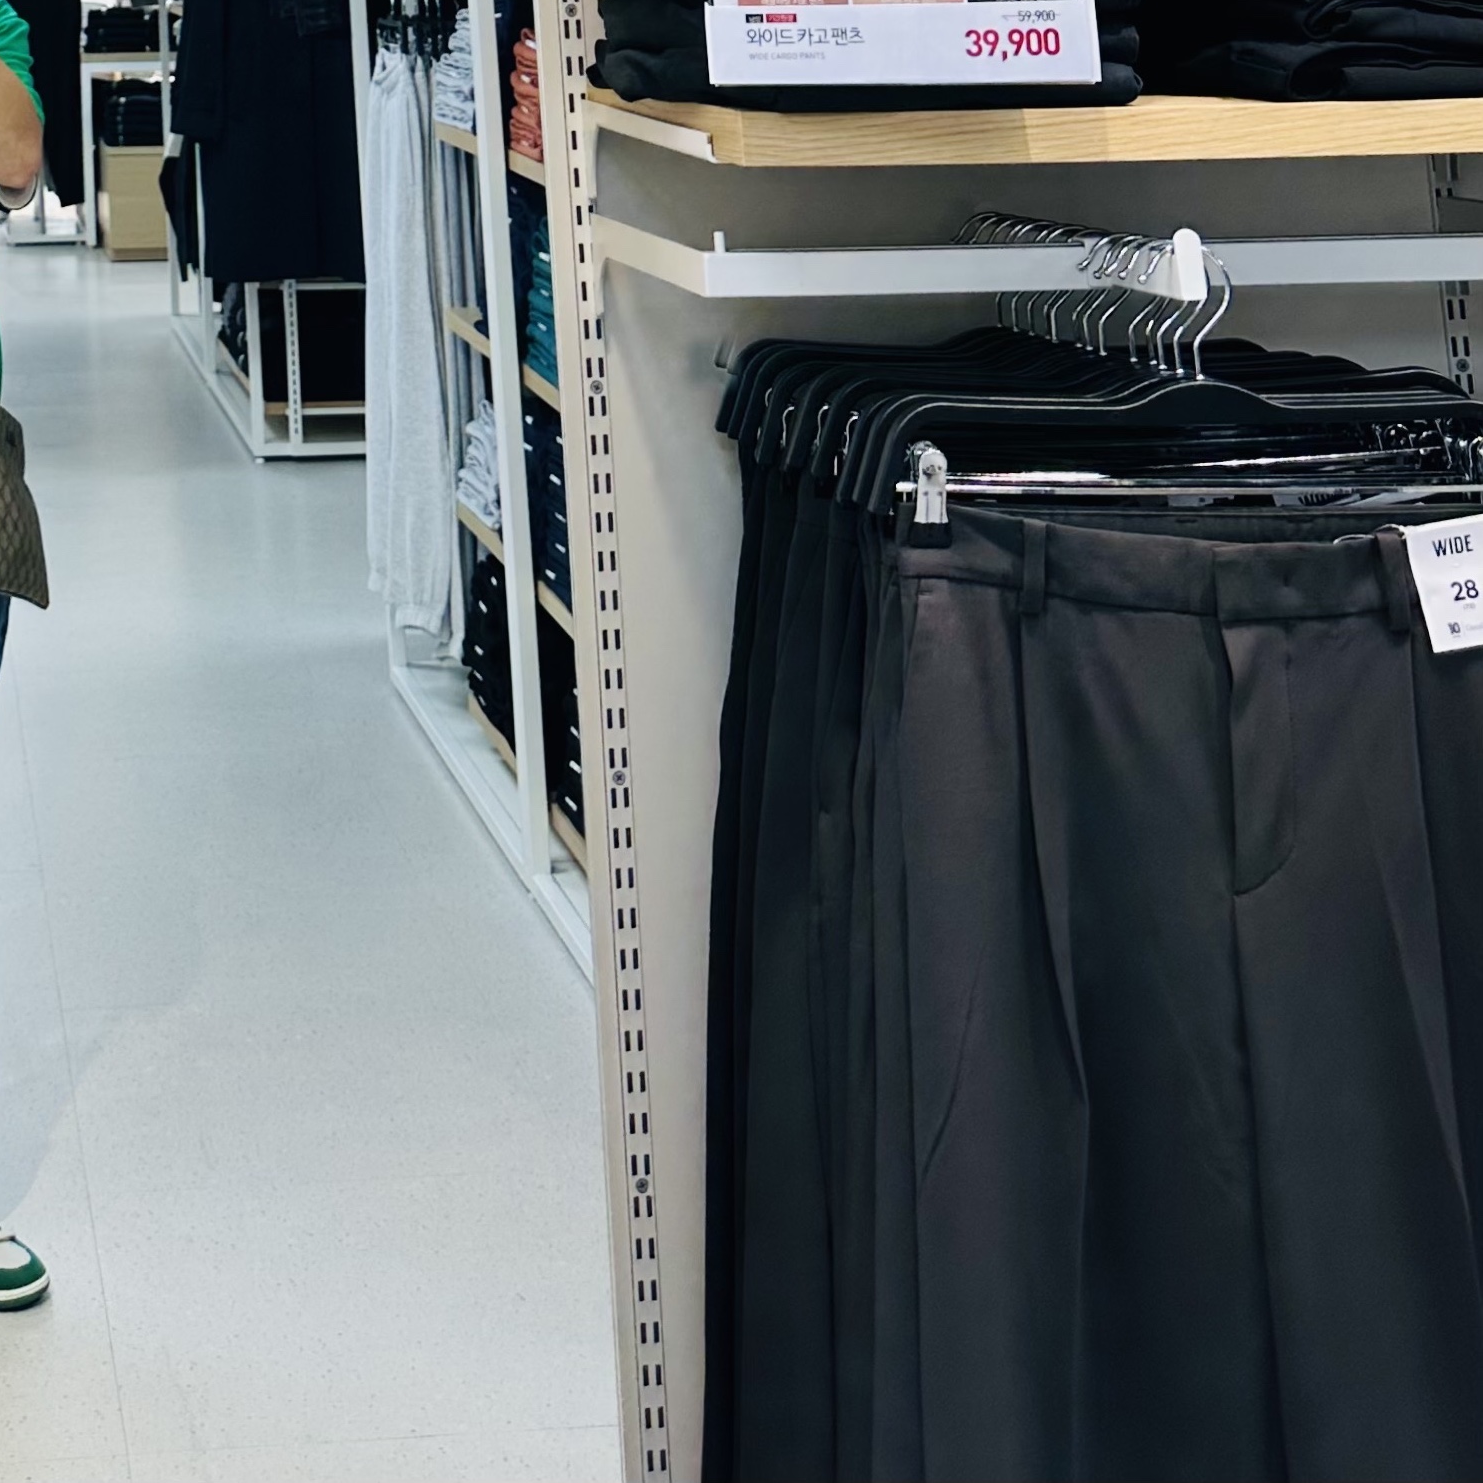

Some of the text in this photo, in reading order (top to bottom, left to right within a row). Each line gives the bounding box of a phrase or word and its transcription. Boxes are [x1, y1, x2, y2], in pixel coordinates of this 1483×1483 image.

[1018, 10, 1056, 24] 59,900
[746, 26, 865, 47] 와이드 카고 팬츠
[964, 27, 1061, 62] 39,900
[749, 52, 826, 60] WIDE CARGO PANTS
[1432, 534, 1474, 558] WIDE
[1450, 579, 1479, 602] 28
